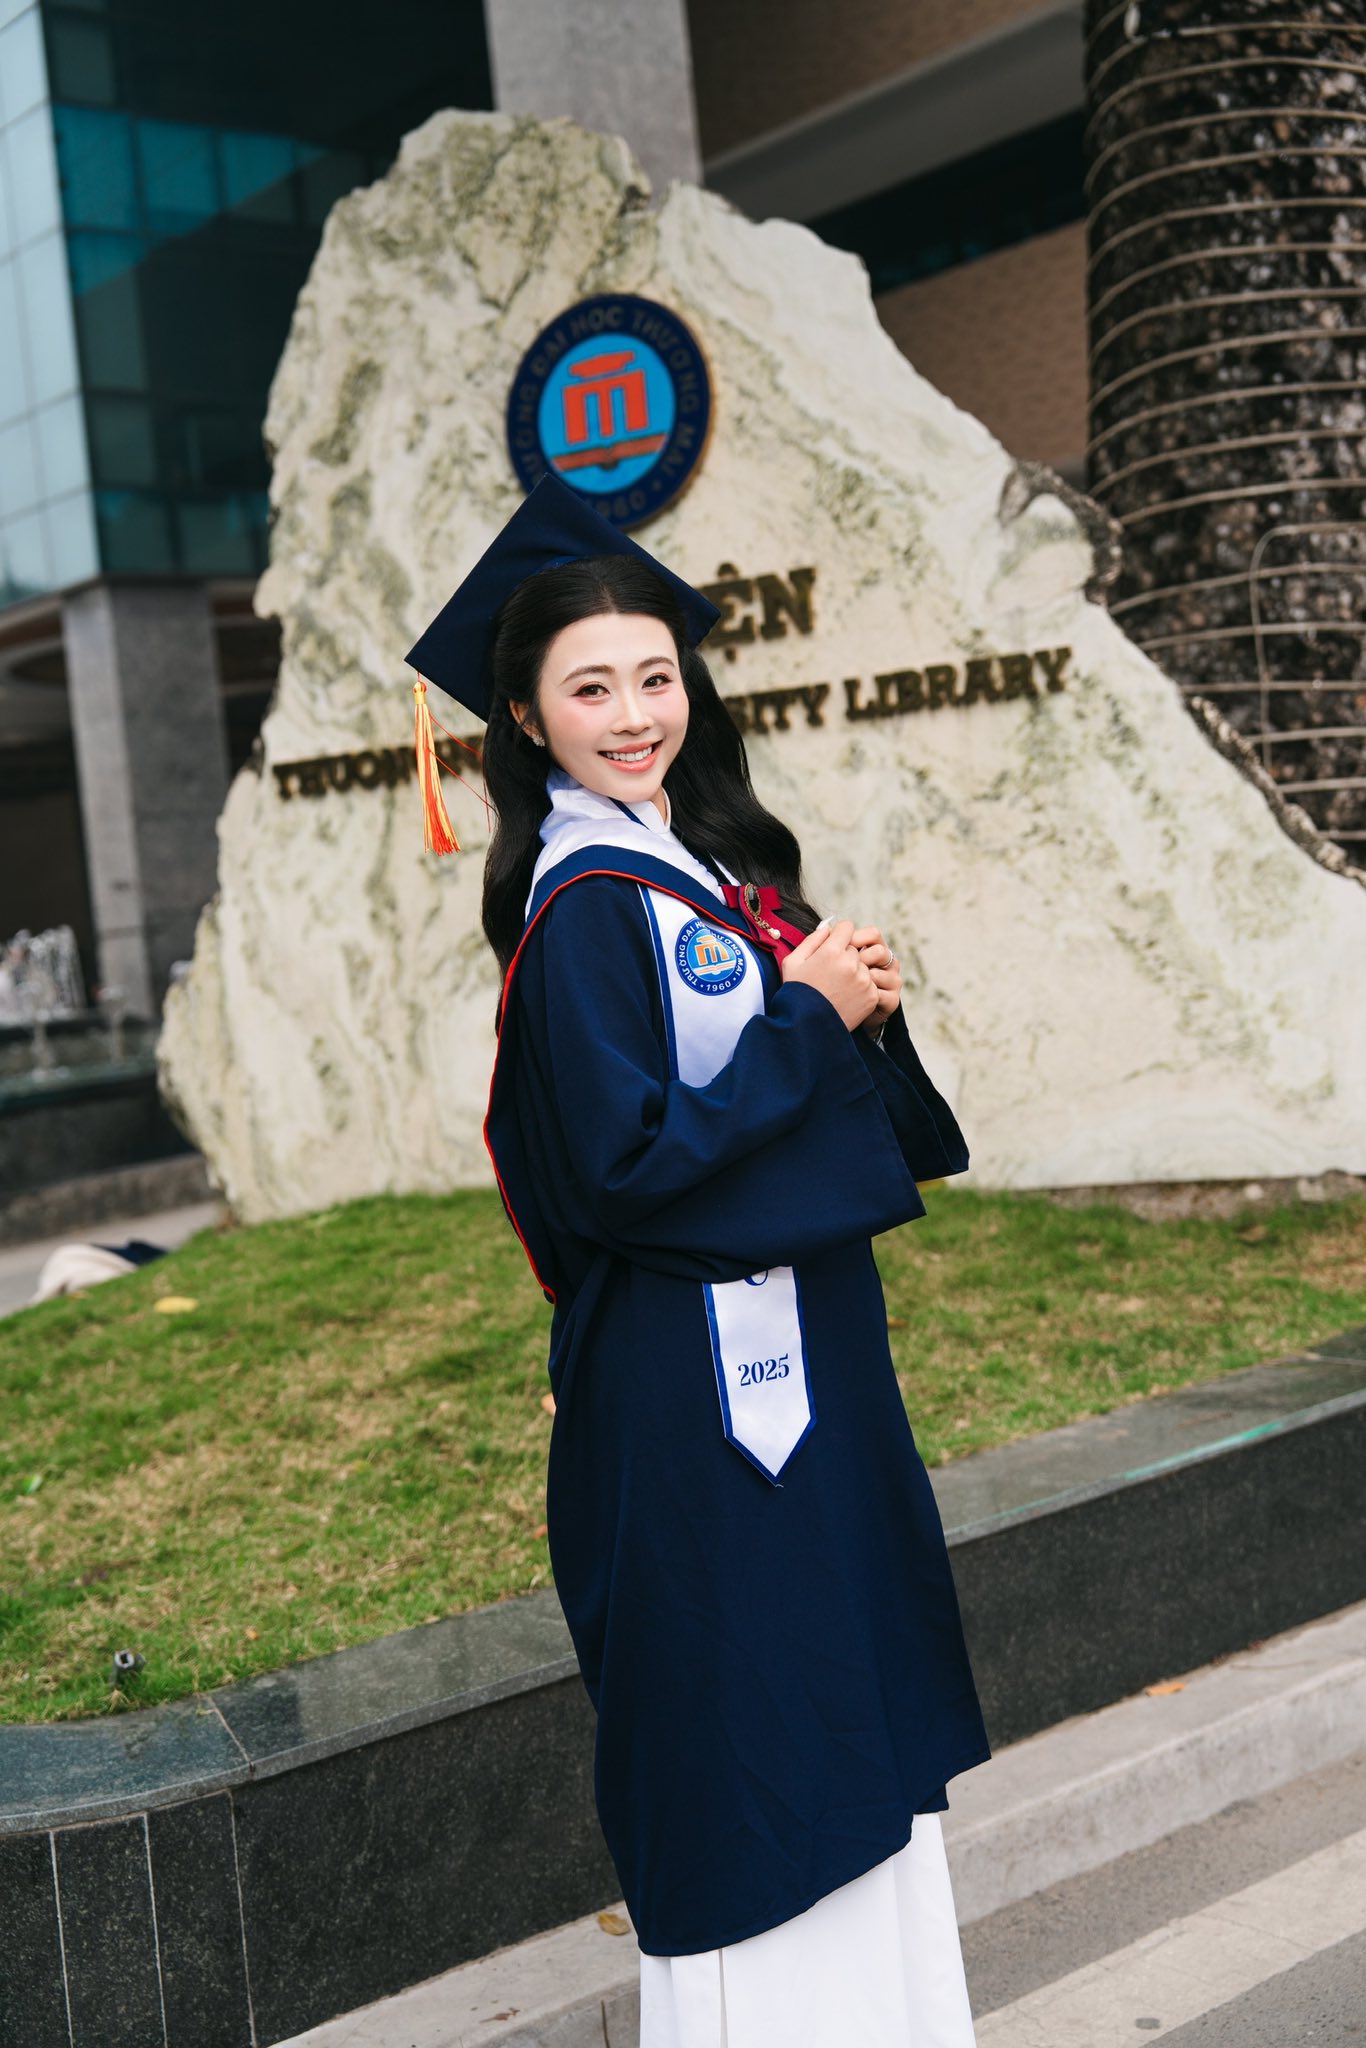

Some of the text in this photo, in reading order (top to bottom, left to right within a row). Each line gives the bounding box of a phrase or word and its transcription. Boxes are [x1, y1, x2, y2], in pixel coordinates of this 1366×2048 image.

[844, 647, 1072, 721] LIBRARY
[681, 926, 695, 942] ĐẠI
[678, 944, 698, 986] TRƯỜNG
[706, 980, 731, 992] 1960
[738, 1353, 790, 1387] 2025
